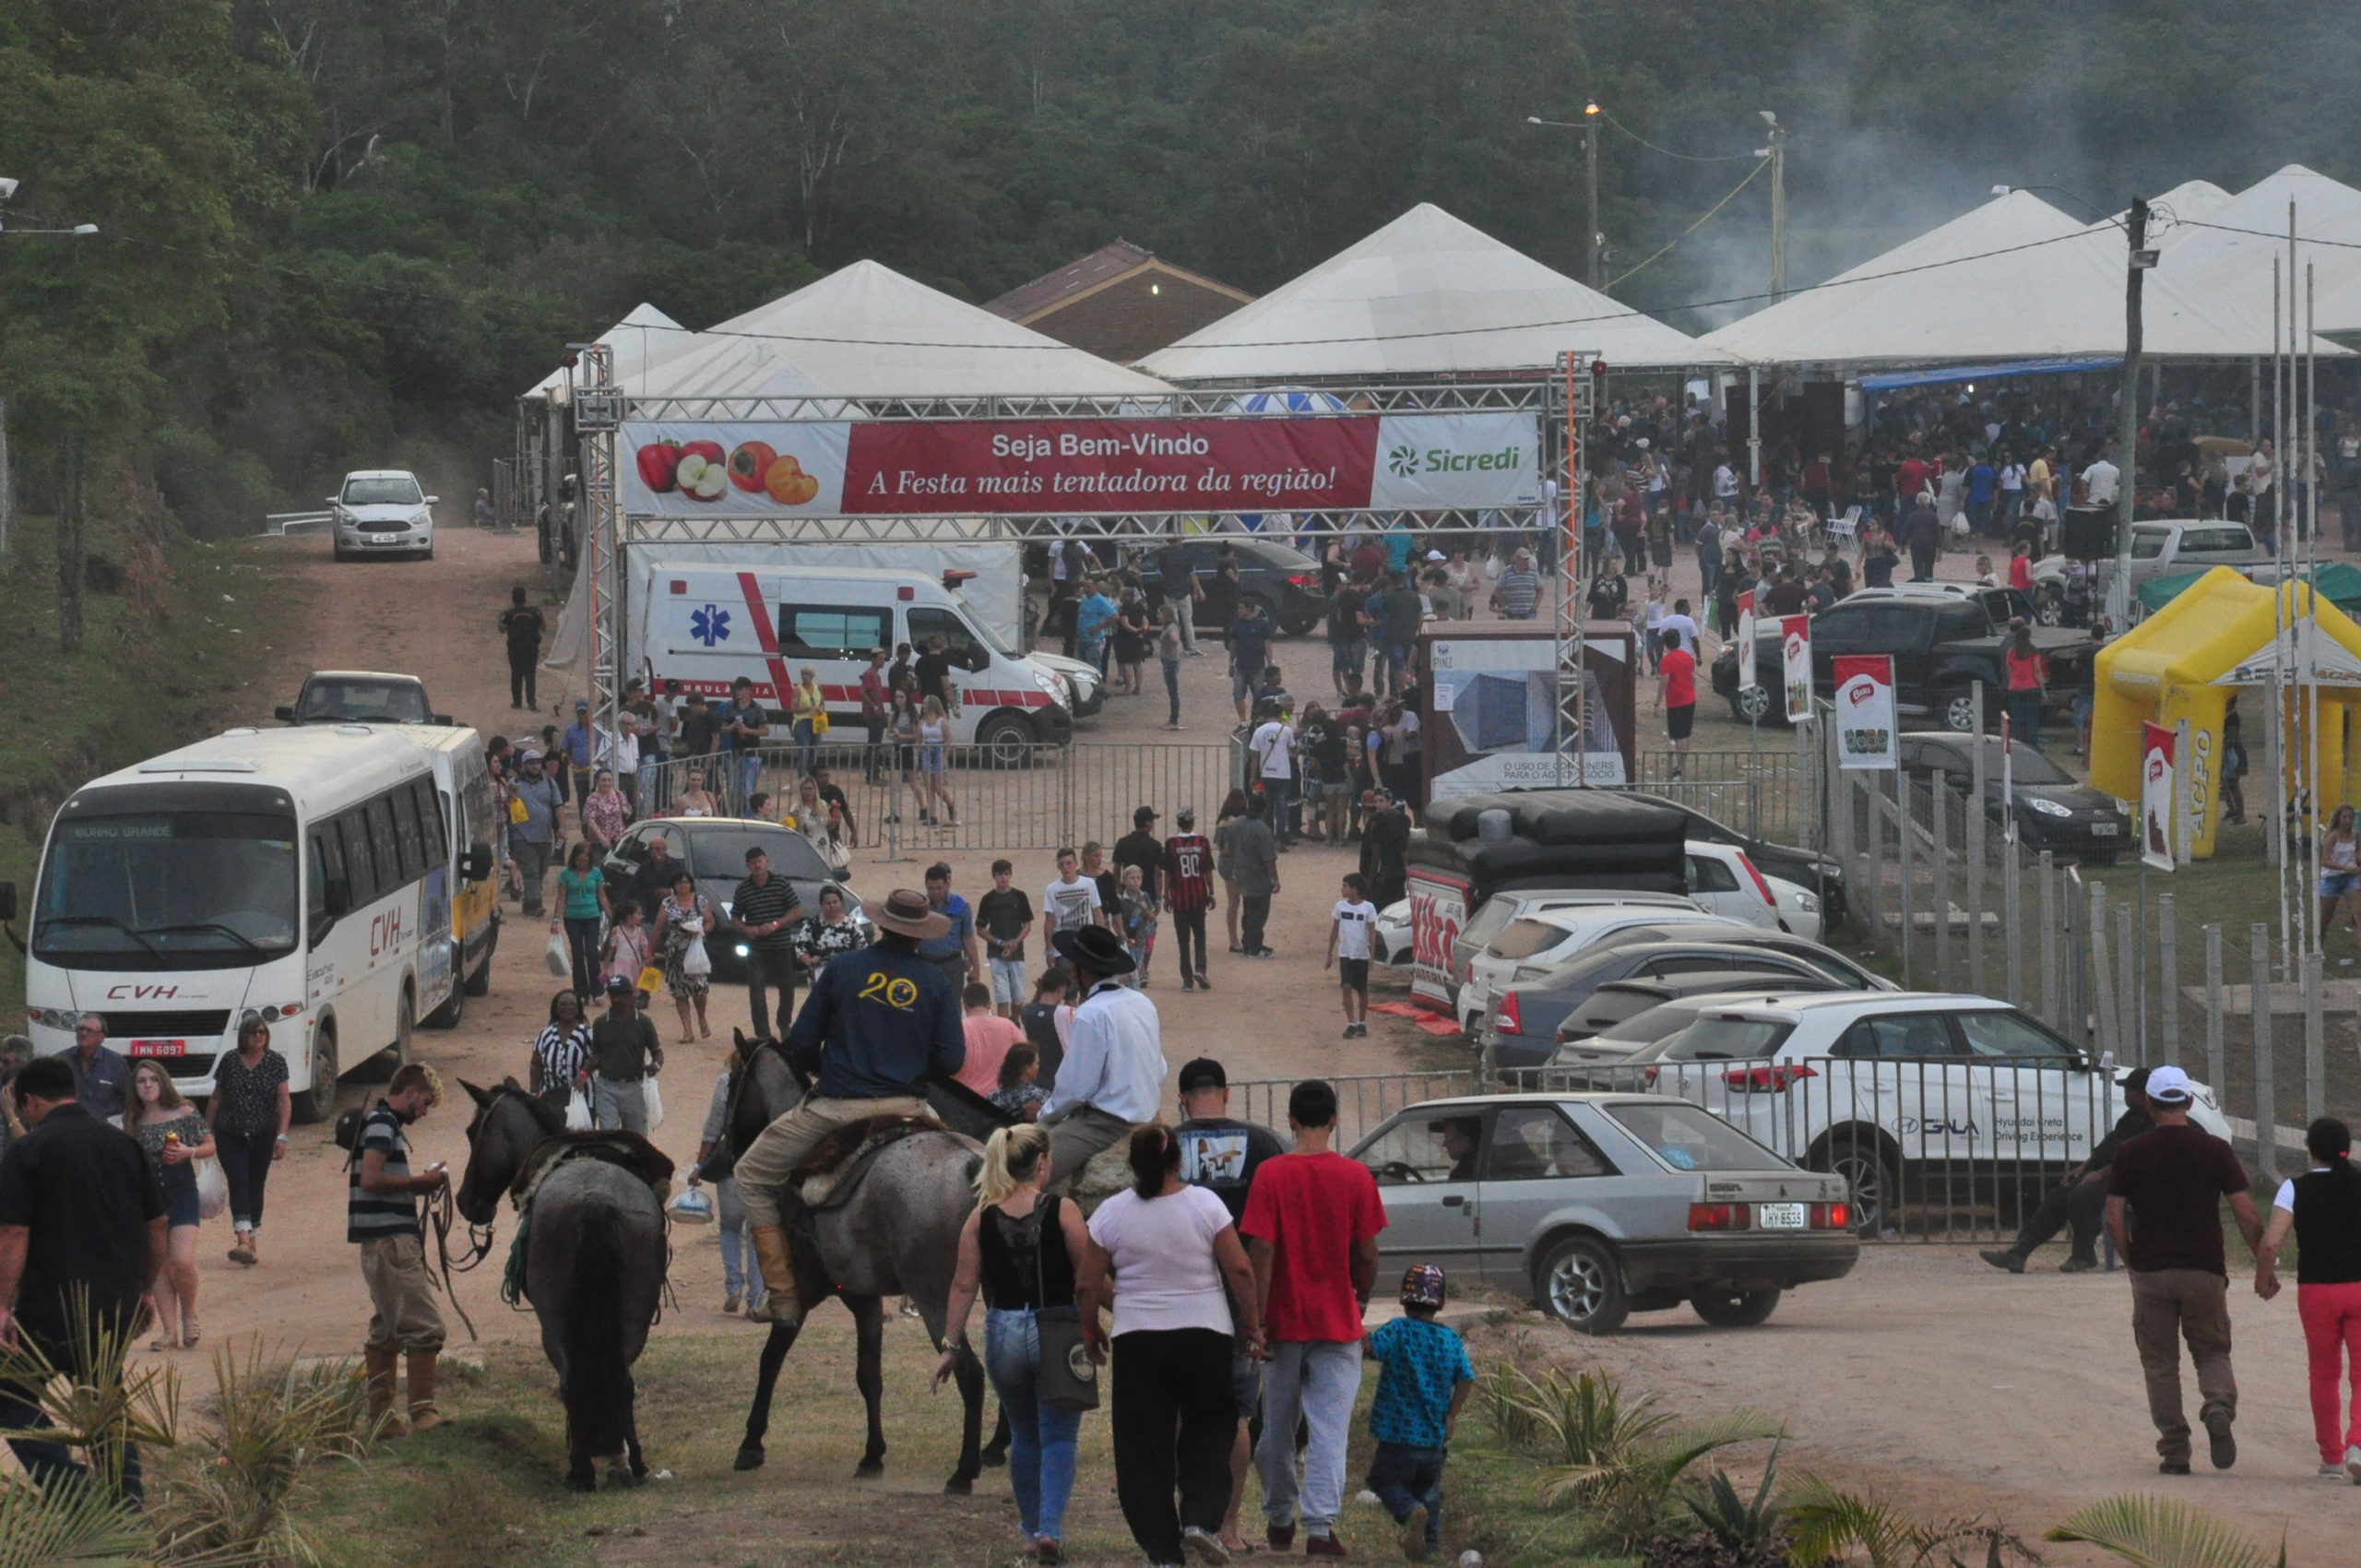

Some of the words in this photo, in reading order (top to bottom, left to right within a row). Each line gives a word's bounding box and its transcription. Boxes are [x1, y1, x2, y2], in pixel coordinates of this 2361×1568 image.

[992, 434, 1051, 461] Seja
[1061, 432, 1210, 457] Bem-Vindo
[1425, 446, 1520, 472] Sicredi
[867, 470, 887, 494] A
[896, 470, 967, 494] Festa
[976, 470, 1043, 493] mais
[1052, 469, 1188, 493] tentadora
[1197, 468, 1232, 491] da
[1240, 466, 1337, 497] região!
[1432, 657, 1453, 670] PINZ
[1504, 762, 1513, 770] O
[1515, 762, 1535, 770] USO
[1537, 762, 1551, 770] DE
[1553, 761, 1615, 770] COINERS
[1504, 771, 1529, 779] PARA
[1532, 771, 1539, 779] O
[1180, 854, 1200, 878] 80
[371, 906, 401, 956] CVH
[107, 985, 179, 999] CVH
[858, 971, 918, 1009] 20
[156, 1045, 183, 1055] 6097
[2038, 1118, 2063, 1127] reta
